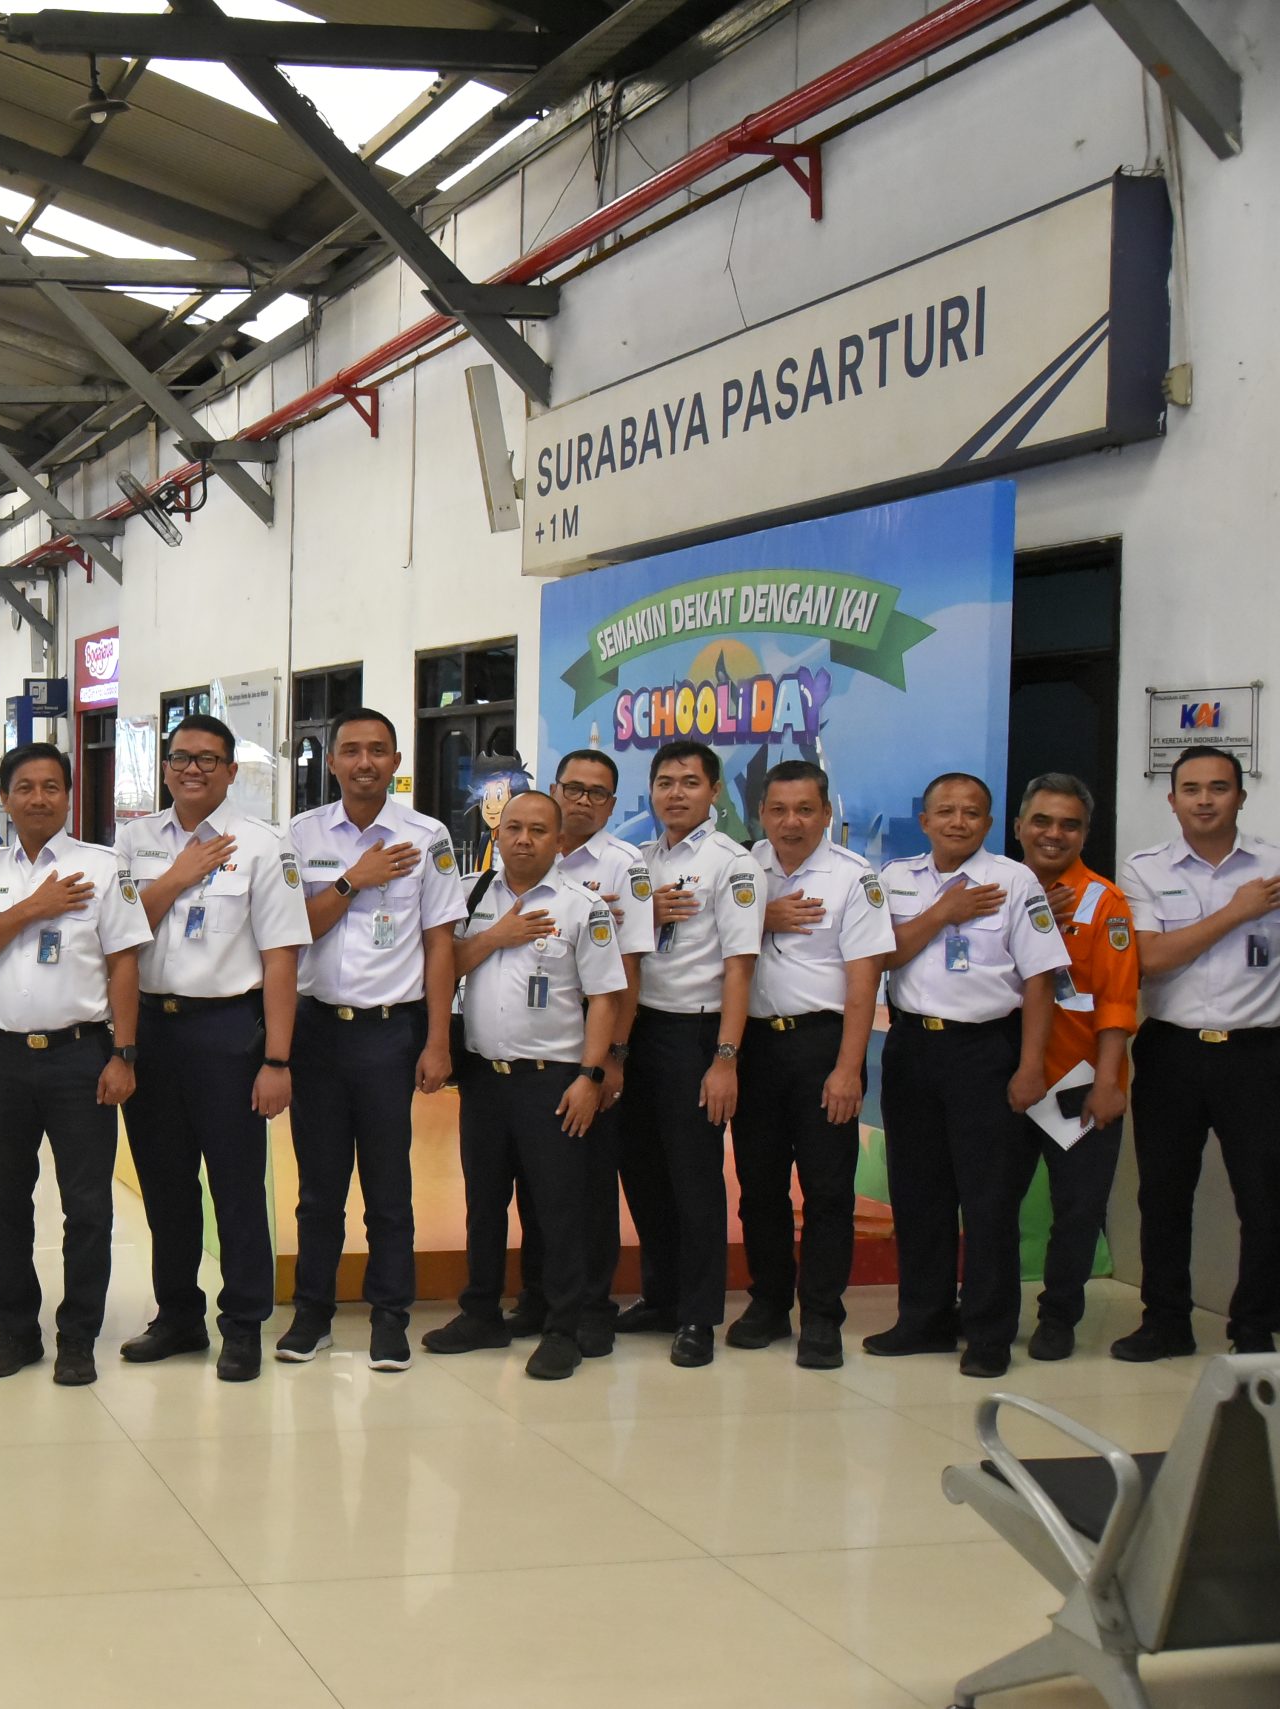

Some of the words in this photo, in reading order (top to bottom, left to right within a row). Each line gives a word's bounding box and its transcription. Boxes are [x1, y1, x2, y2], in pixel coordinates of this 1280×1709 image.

[536, 391, 710, 497] SURABAYA
[721, 285, 987, 439] PASARTURI
[596, 605, 668, 662] SEMAKIN
[670, 587, 736, 633] DEKAT
[738, 583, 833, 626] DENGAN
[835, 587, 879, 633] KAI
[1180, 702, 1220, 729] KAI
[1193, 736, 1223, 744] INDONESIA
